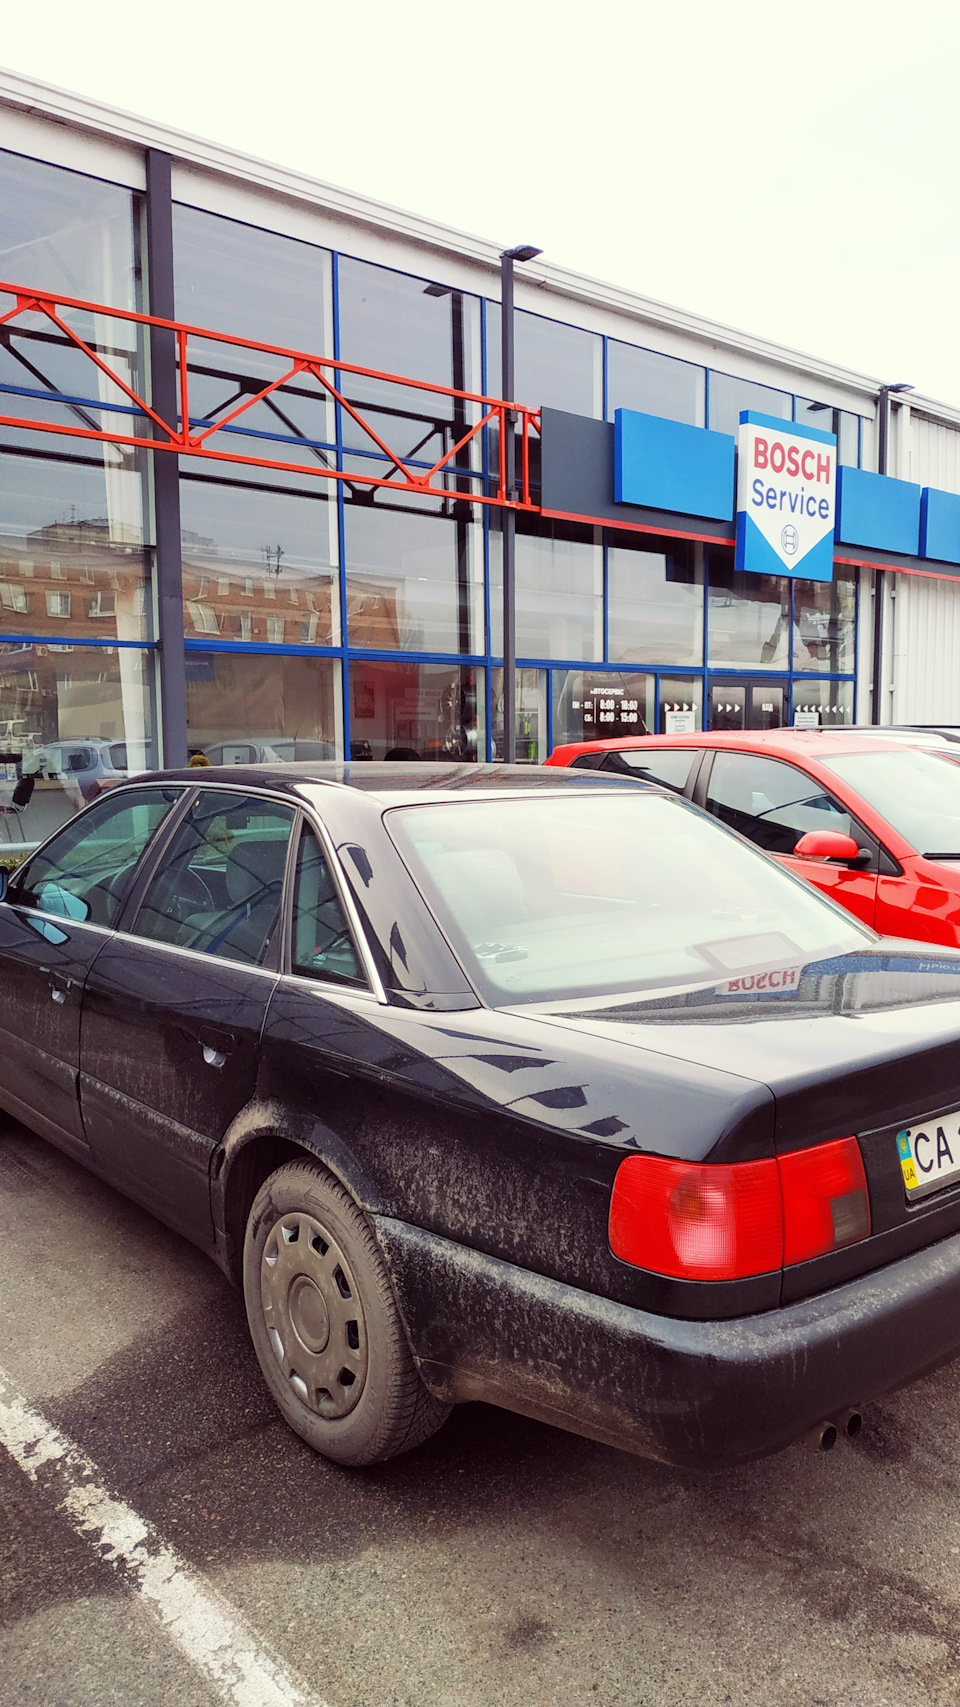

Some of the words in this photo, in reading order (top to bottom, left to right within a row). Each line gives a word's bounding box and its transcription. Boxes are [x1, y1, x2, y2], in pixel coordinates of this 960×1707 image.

[754, 437, 830, 484] BOSCH
[752, 479, 829, 519] Service
[600, 699, 615, 710] 8:00
[620, 700, 638, 710] 18:00
[600, 711, 615, 722] 8:00
[620, 712, 638, 723] 15:00
[914, 1126, 954, 1173] CA
[904, 1168, 916, 1181] UA
